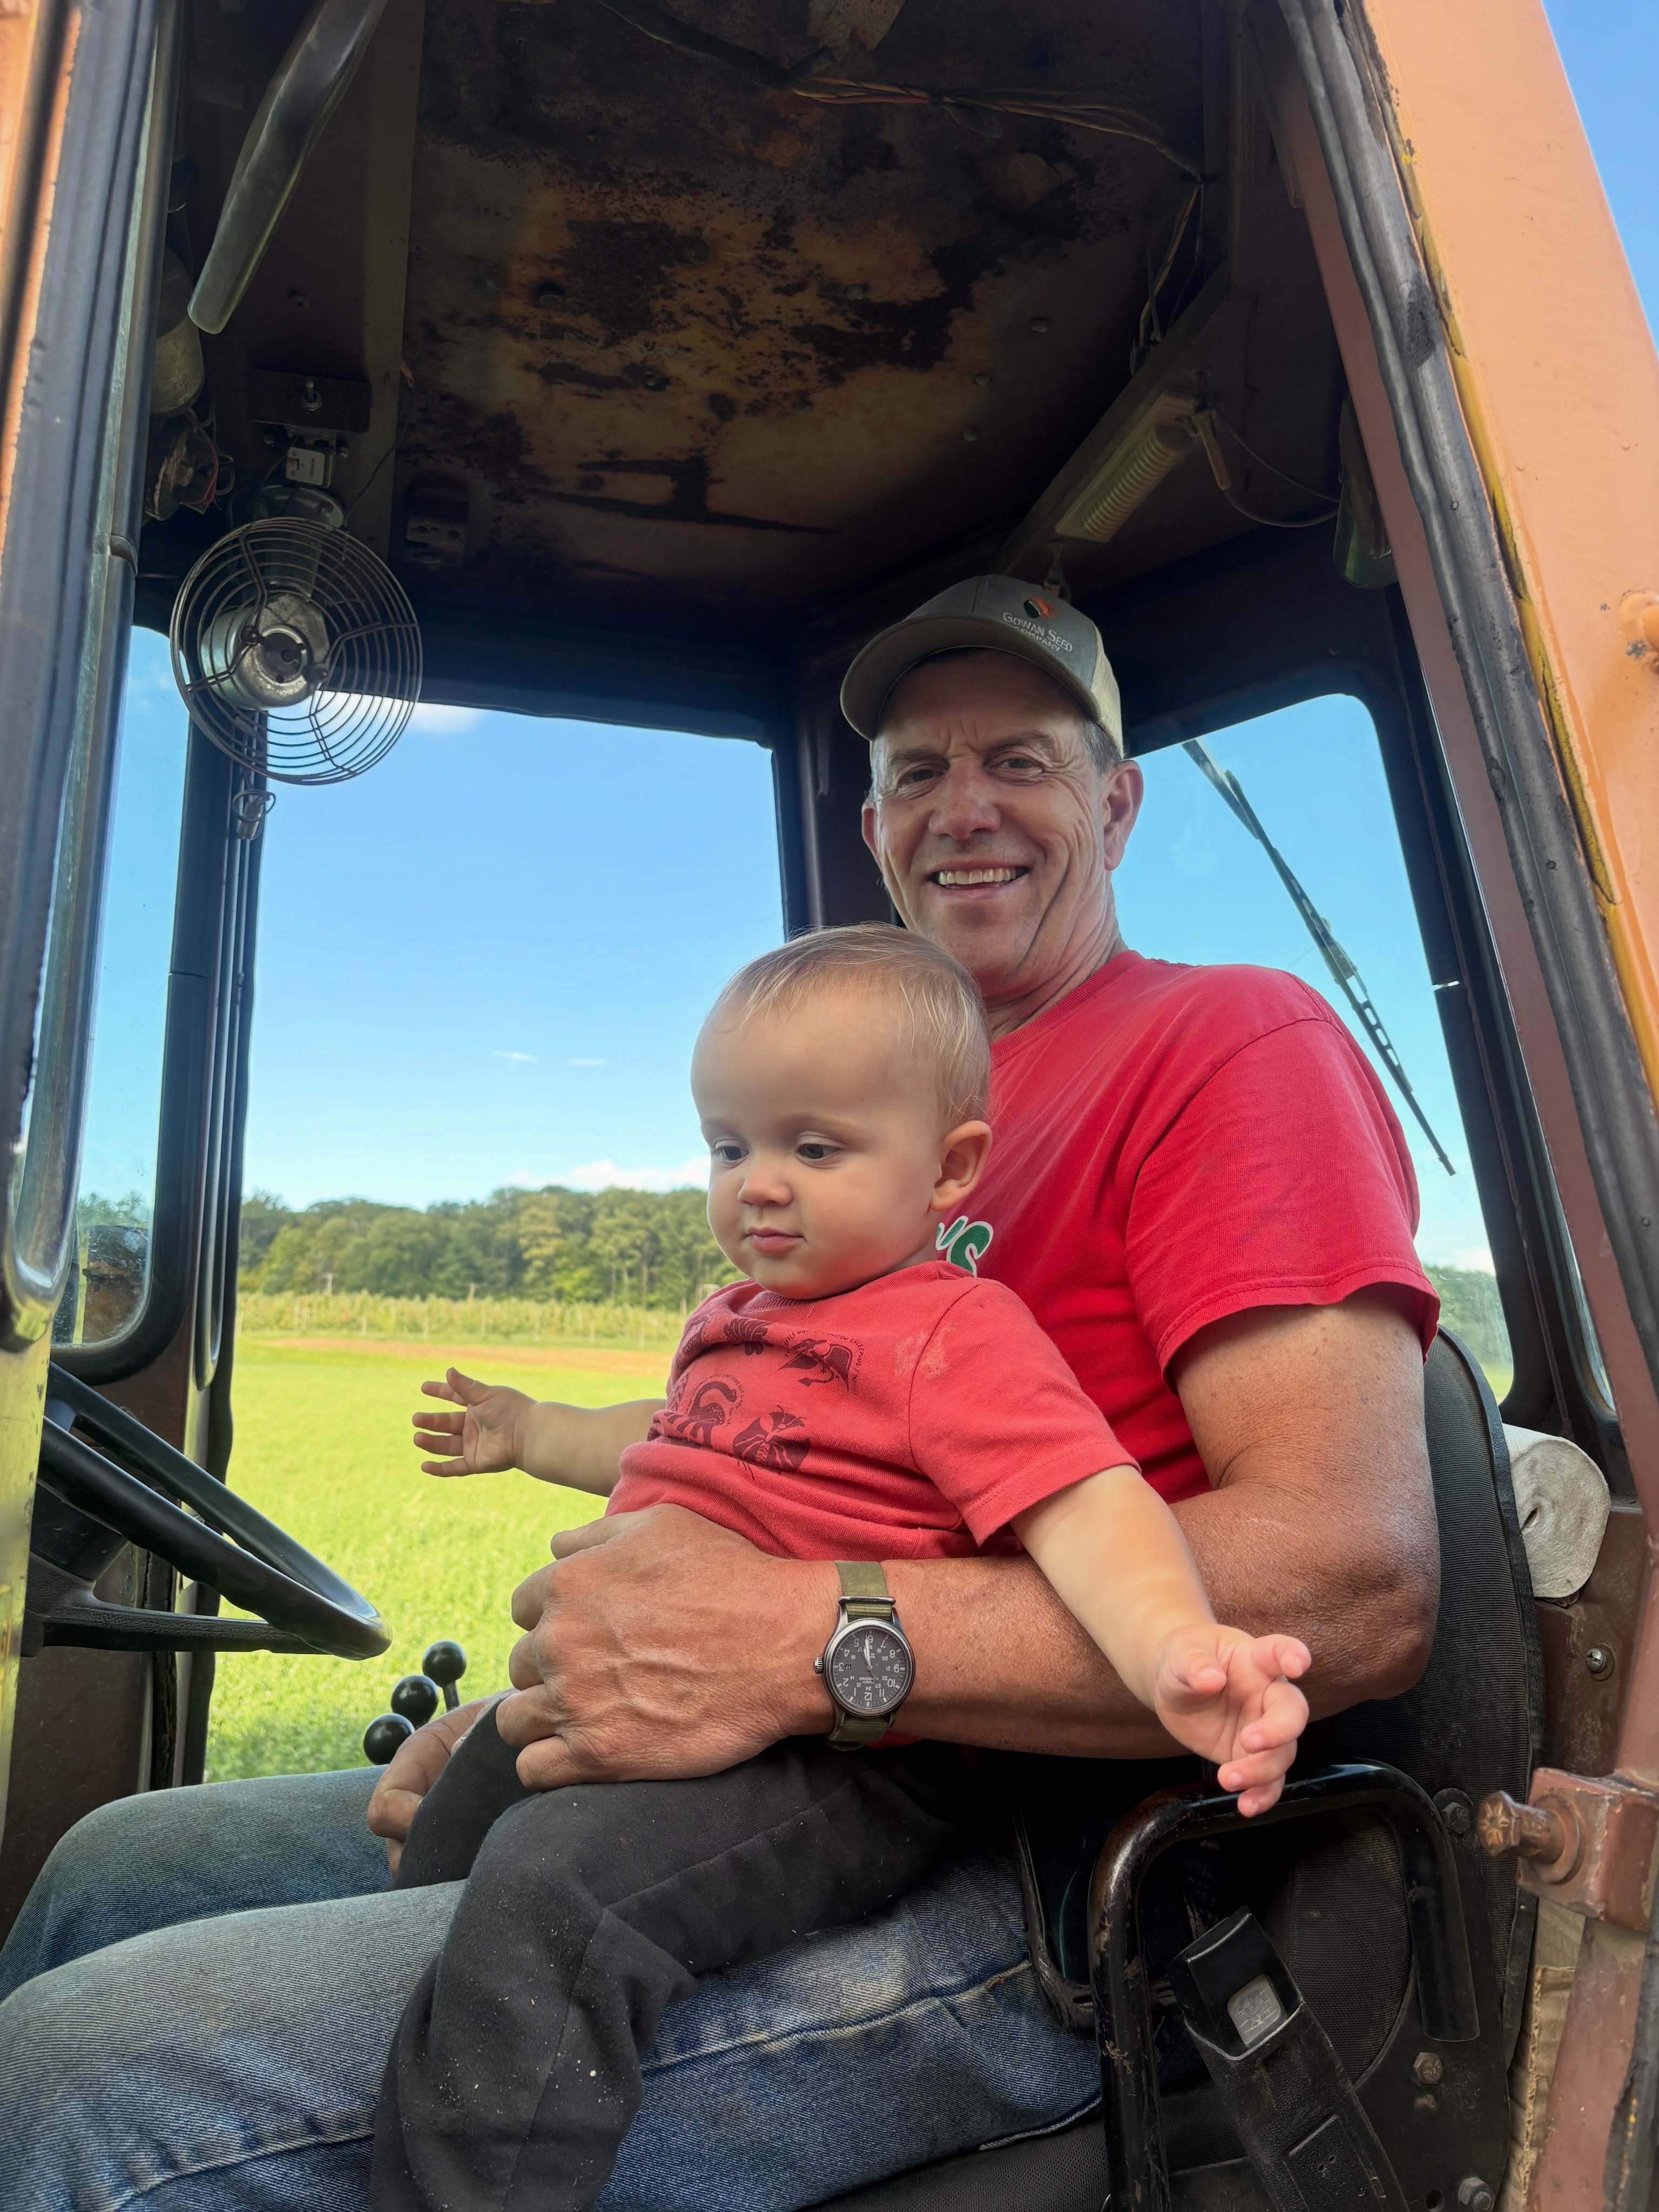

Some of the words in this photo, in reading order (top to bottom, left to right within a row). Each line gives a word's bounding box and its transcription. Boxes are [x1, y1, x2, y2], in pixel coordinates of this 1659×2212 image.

[1003, 612, 1044, 637] GOWAN
[1048, 630, 1073, 652] SEED
[1014, 626, 1060, 651] OMPANY
[854, 1638, 859, 1647] 5
[868, 1635, 873, 1643] 6
[880, 1639, 886, 1648] 7
[844, 1648, 850, 1657] 4
[889, 1649, 895, 1658] 8
[838, 1662, 844, 1671] 3
[894, 1664, 900, 1673] 9
[843, 1678, 848, 1687] 2
[887, 1678, 895, 1687] 10
[854, 1688, 856, 1696] 1
[864, 1692, 872, 1701] 12
[879, 1688, 885, 1697] 11
